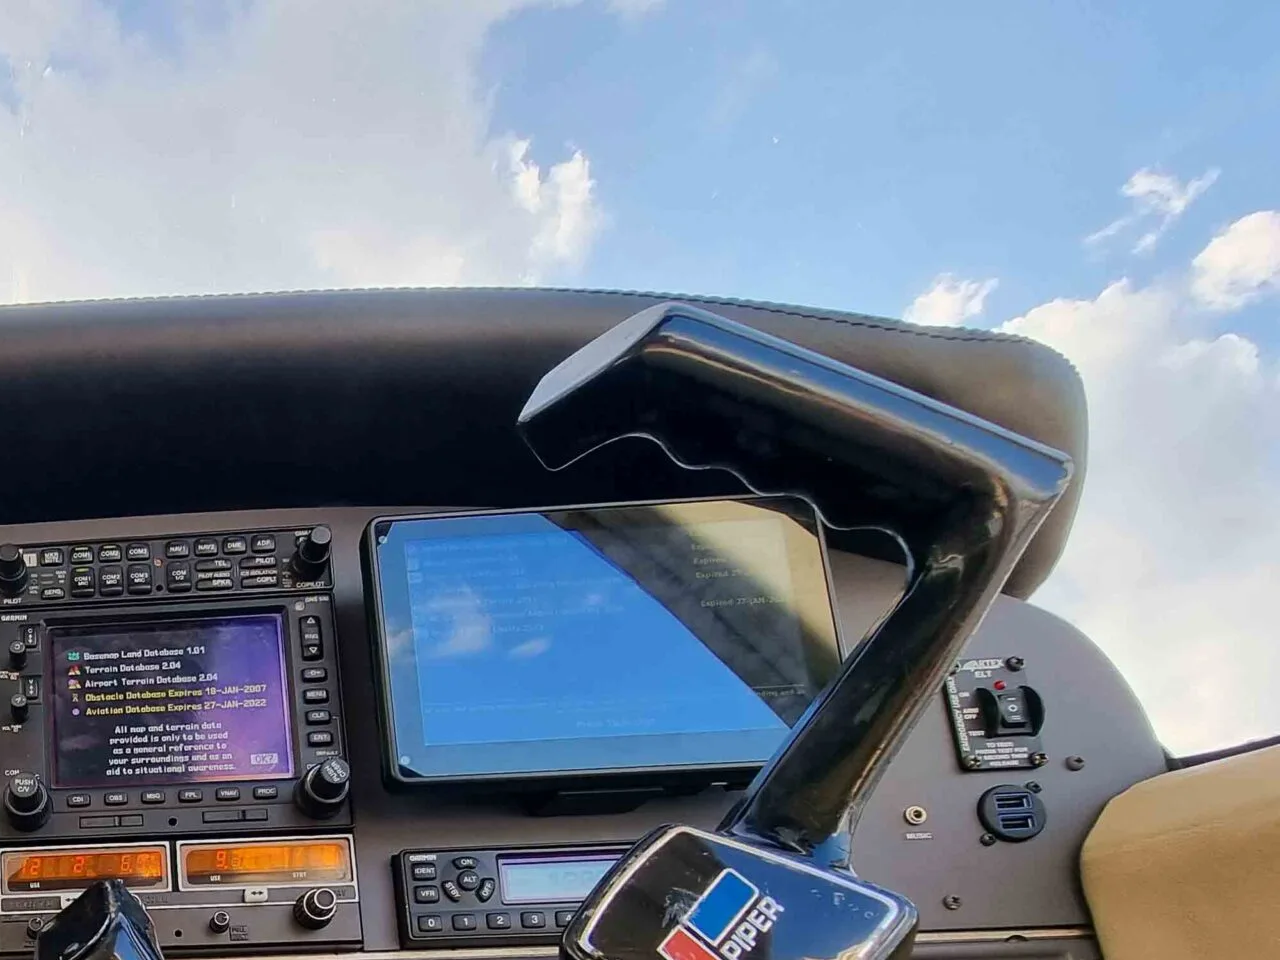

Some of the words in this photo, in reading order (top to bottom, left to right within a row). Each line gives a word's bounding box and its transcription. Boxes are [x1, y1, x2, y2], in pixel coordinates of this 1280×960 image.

[84, 652, 119, 660] Basemap
[144, 649, 183, 657] Database
[186, 646, 205, 654] 1.01
[85, 665, 118, 674] Terrain
[120, 663, 159, 672] Database
[157, 675, 196, 684] Database
[199, 673, 218, 681] 2.04
[85, 693, 124, 701] Obstacle
[126, 691, 166, 699] Database
[168, 689, 202, 698] Expires
[86, 707, 123, 715] Aviation
[126, 705, 165, 714] Database
[168, 703, 202, 712] Expires
[205, 699, 267, 709] 27-JAN-2022
[115, 725, 127, 733] All
[148, 724, 163, 732] and
[166, 723, 199, 731] terrain
[110, 736, 148, 745] provided
[162, 734, 179, 743] only
[134, 744, 166, 754] general
[169, 743, 214, 752] reference
[131, 755, 189, 764] surroundings
[106, 767, 120, 776] aid
[135, 765, 185, 774] situational
[445, 882, 461, 898] STBY
[482, 884, 492, 897] OFF
